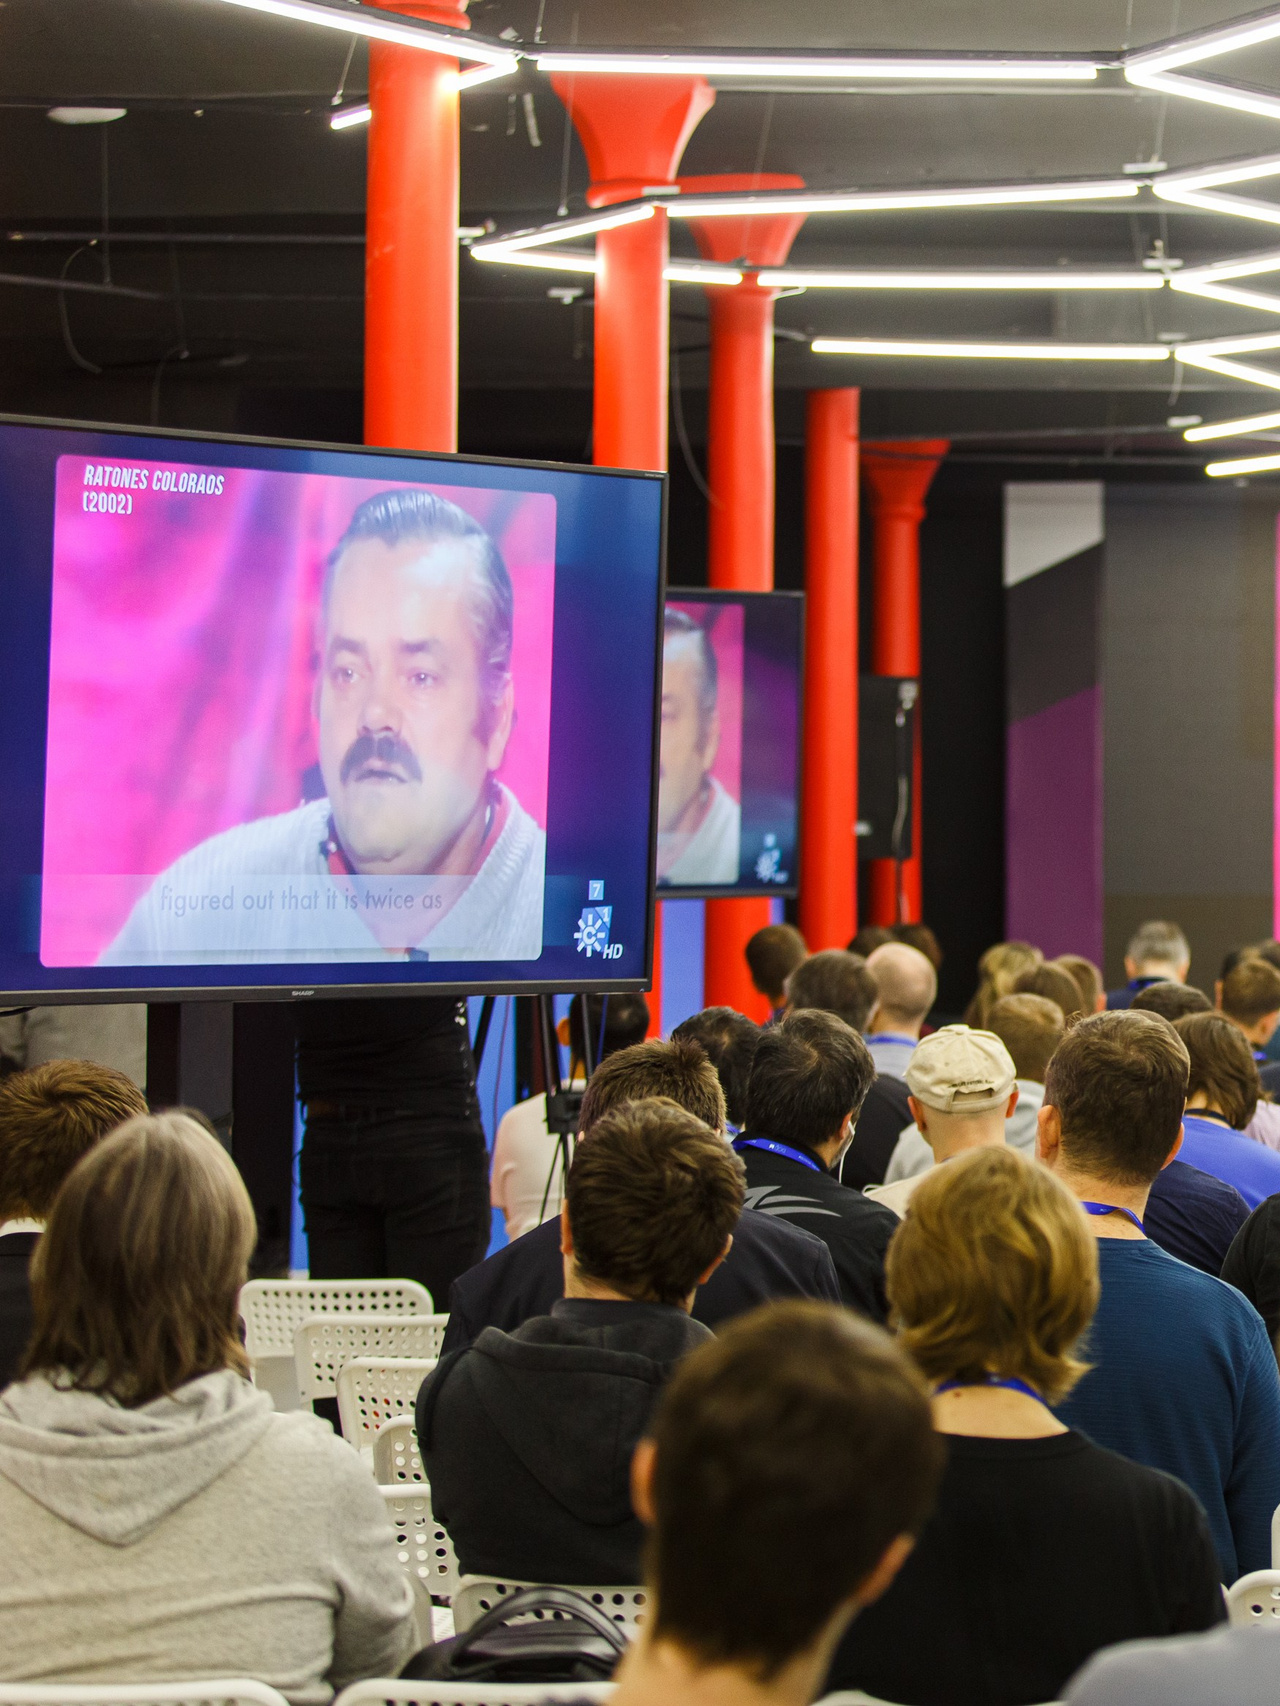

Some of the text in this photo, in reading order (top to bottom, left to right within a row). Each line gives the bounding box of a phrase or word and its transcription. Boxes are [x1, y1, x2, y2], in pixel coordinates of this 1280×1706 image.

[84, 464, 225, 496] RATONES COLORAOS
[82, 491, 133, 515] (2002)
[161, 885, 443, 917] figured out that it is twice as
[592, 883, 601, 898] 7
[602, 943, 623, 959] HD
